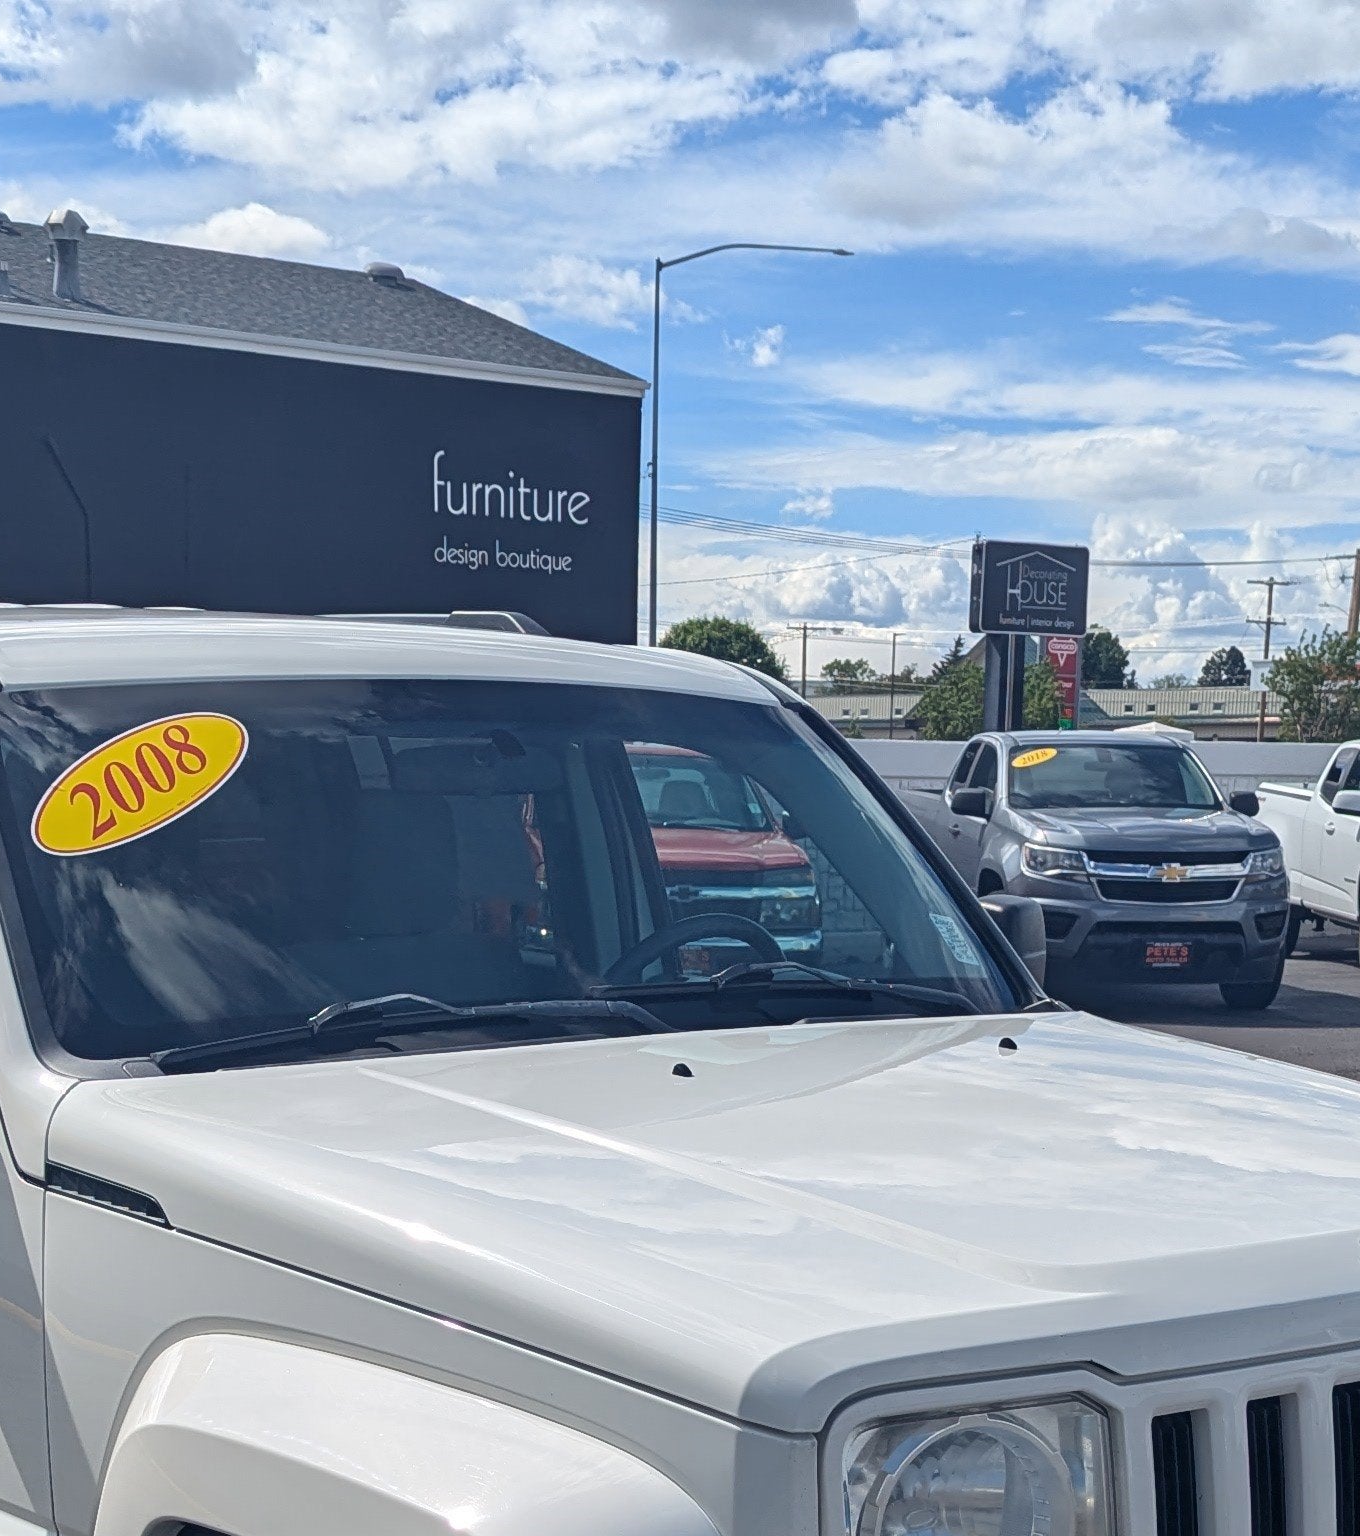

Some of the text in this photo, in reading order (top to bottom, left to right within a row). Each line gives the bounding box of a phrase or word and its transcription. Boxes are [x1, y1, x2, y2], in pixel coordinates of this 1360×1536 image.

[433, 450, 590, 525] furniture
[434, 535, 572, 575] design boutique
[69, 724, 207, 840] 2008
[1022, 750, 1048, 765] 2018
